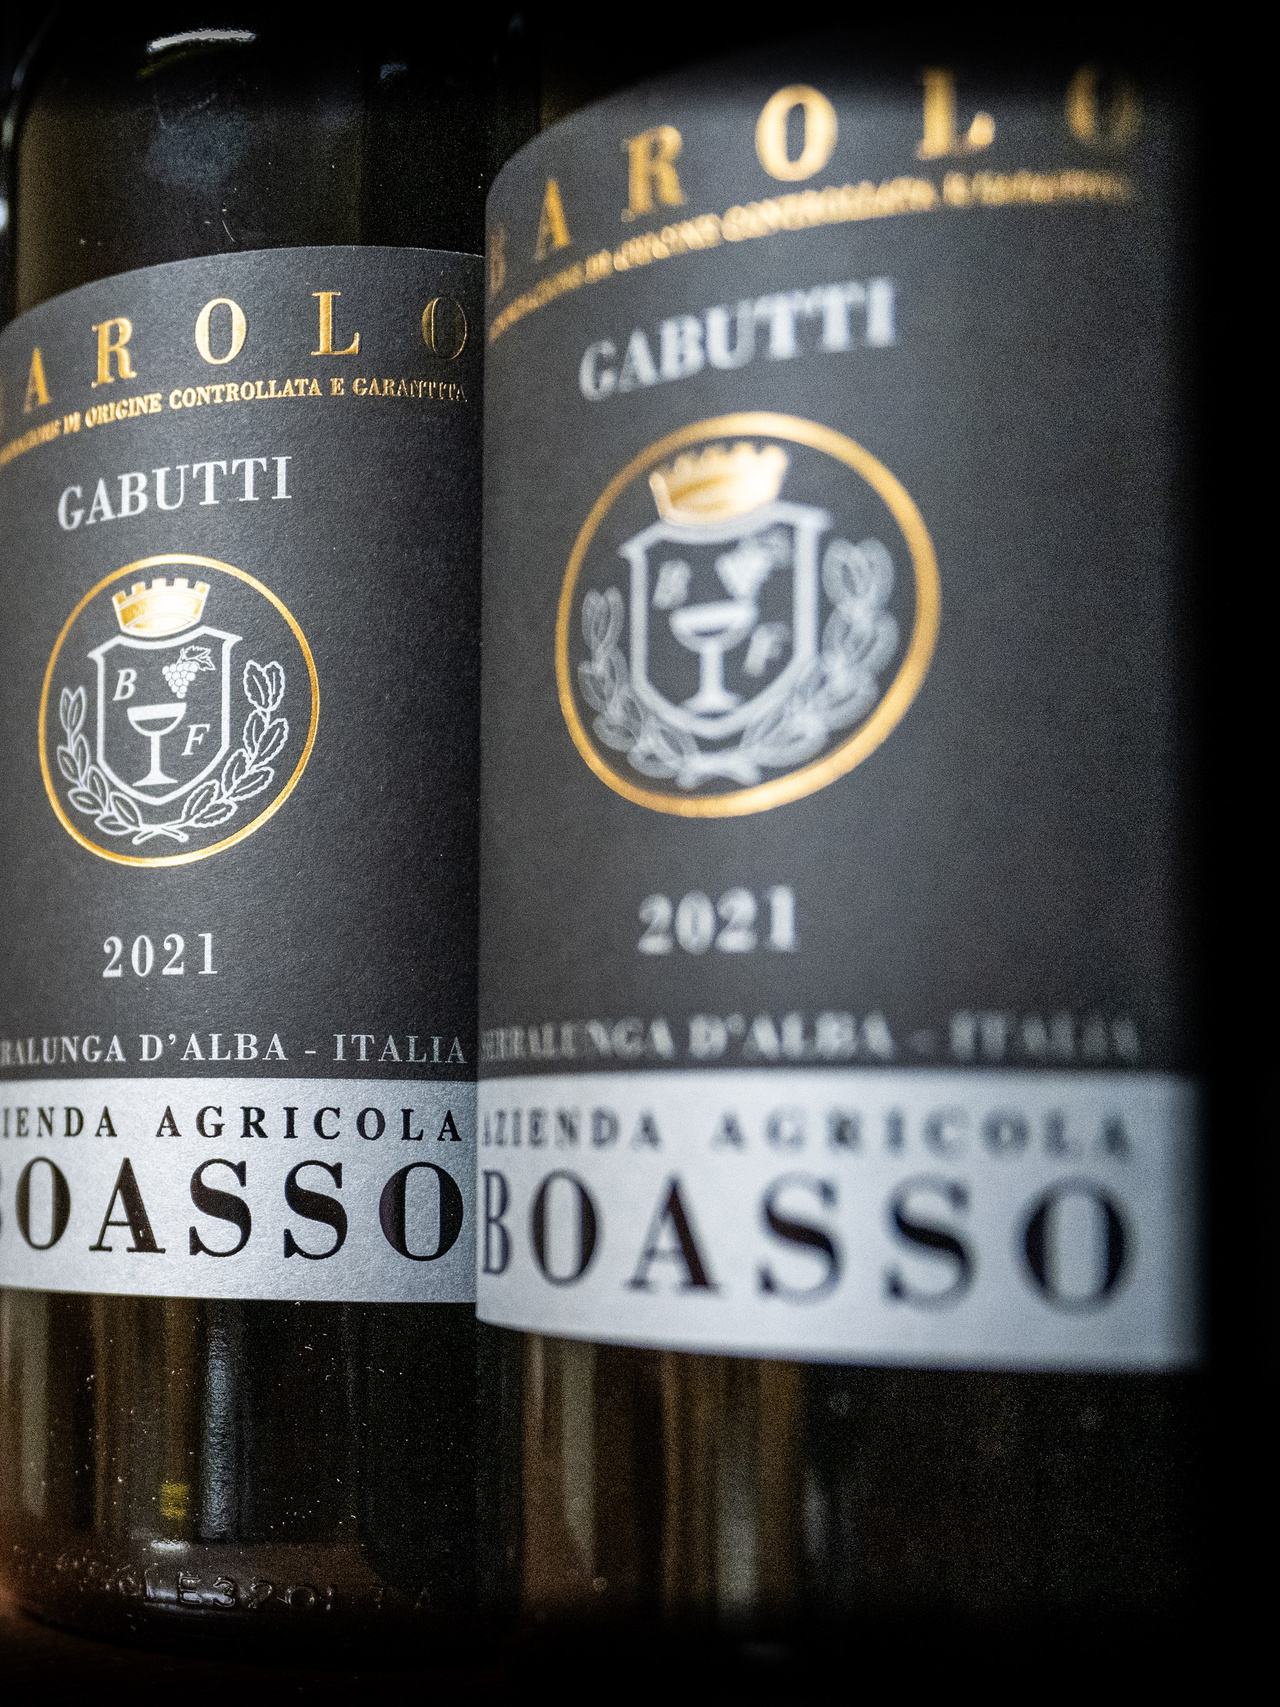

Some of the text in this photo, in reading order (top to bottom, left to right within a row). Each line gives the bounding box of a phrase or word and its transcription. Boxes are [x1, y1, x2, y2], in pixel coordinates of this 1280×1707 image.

[578, 275, 897, 401] GABUTTI
[85, 392, 163, 428] ORIGINE
[169, 378, 323, 410] CONTROLLATA
[330, 377, 344, 396] E
[352, 377, 468, 403] GARANTITA
[57, 455, 294, 531] GABUTTI
[113, 669, 136, 701] B
[181, 723, 210, 757] F
[636, 884, 798, 955] 2021
[102, 932, 219, 978] 2021
[139, 1032, 289, 1063] D'ALBA
[333, 1033, 468, 1065] ITALIA
[156, 1105, 462, 1142] AGRICOLA
[482, 1168, 1134, 1316] BOASSO
